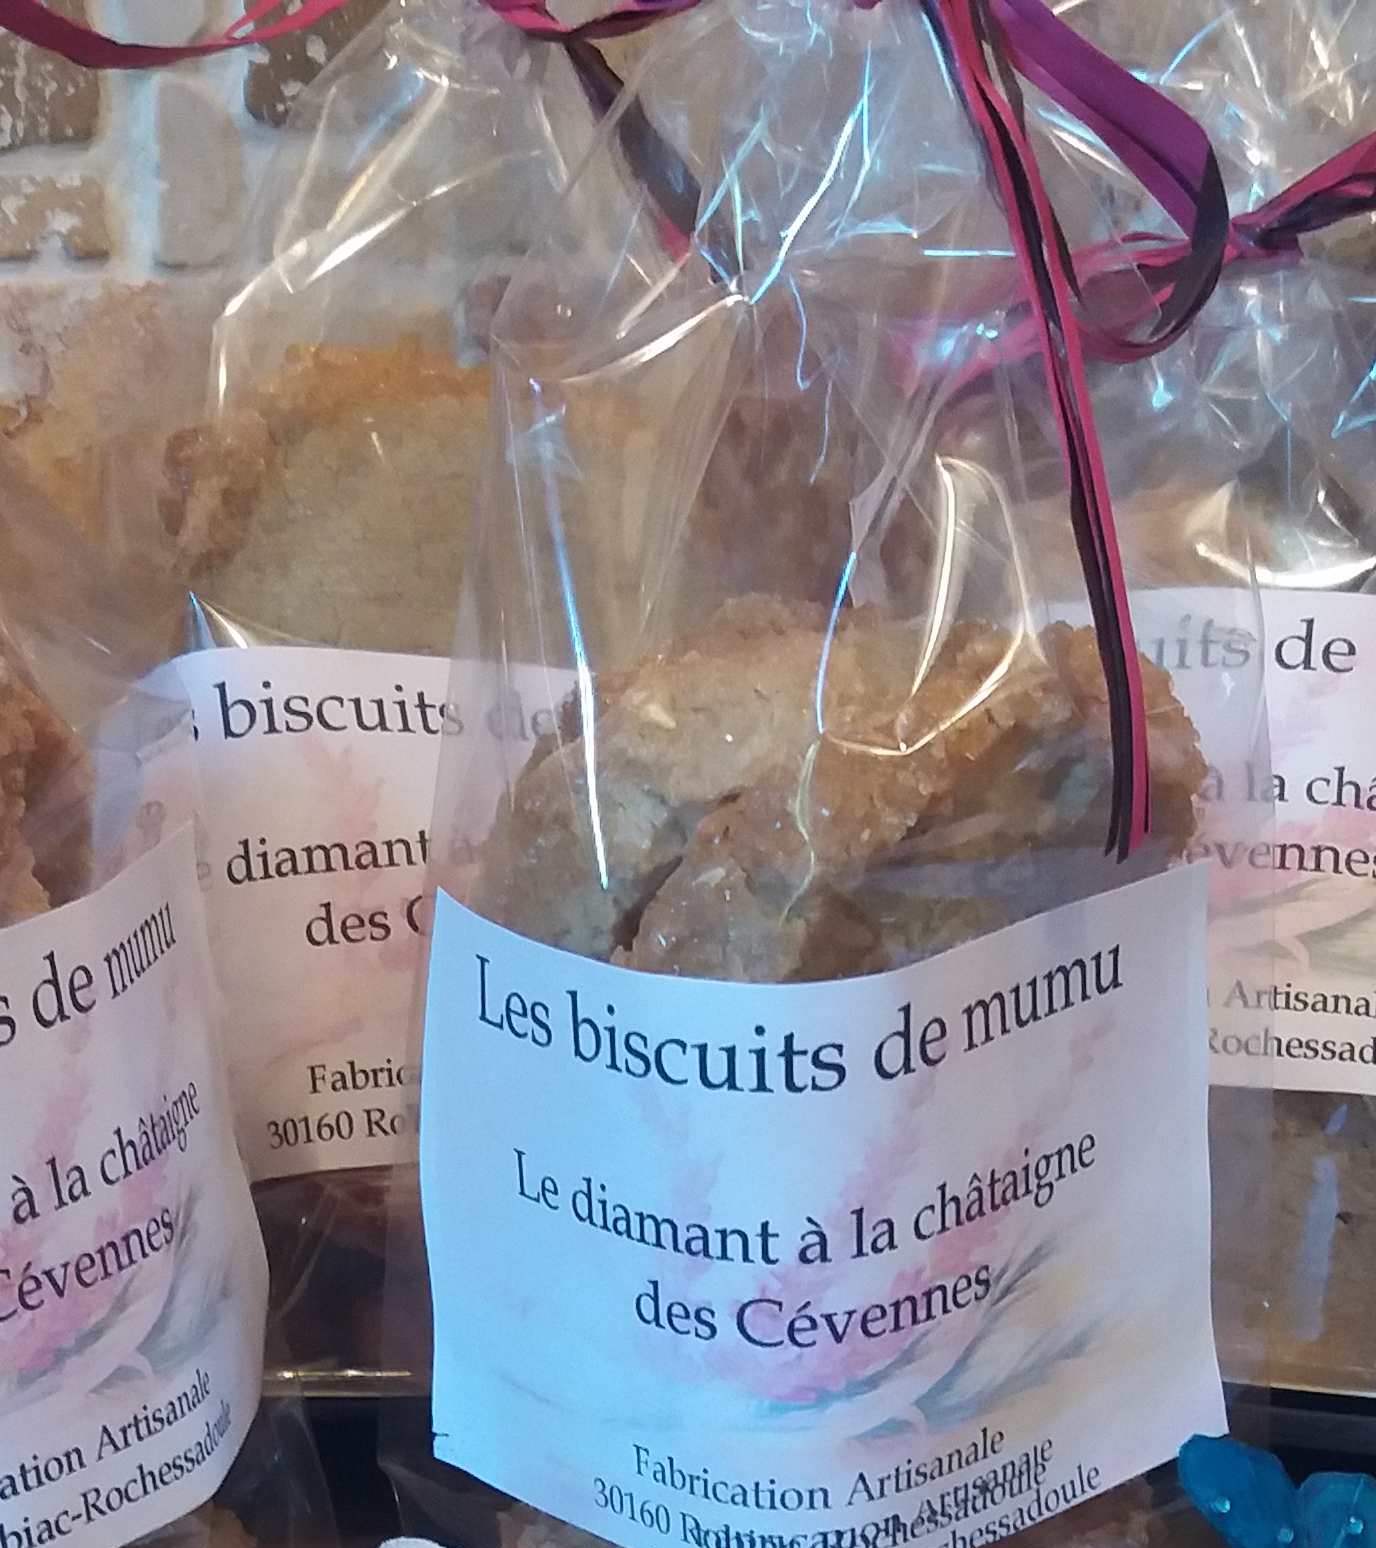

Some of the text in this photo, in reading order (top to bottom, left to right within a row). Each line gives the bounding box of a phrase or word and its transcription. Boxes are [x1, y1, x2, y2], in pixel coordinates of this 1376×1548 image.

[1275, 618, 1357, 673] de
[213, 680, 464, 740] biscuits
[226, 828, 432, 886] diamant
[31, 953, 99, 1029] de
[101, 900, 179, 999] mumu
[305, 901, 392, 948] des
[475, 943, 1125, 1096] Les biscuits de mumu
[12, 1174, 41, 1222] à
[48, 1159, 89, 1211] la
[98, 1077, 202, 1185] châtaigne
[267, 1110, 354, 1149] 30160
[513, 1131, 1098, 1266] Le diamant à la châtaigne
[634, 1262, 993, 1350] des Cévennes
[95, 1367, 211, 1462] Artisanale
[593, 1477, 671, 1536] 30160
[633, 1426, 1005, 1512] Fabrication Artisanale
